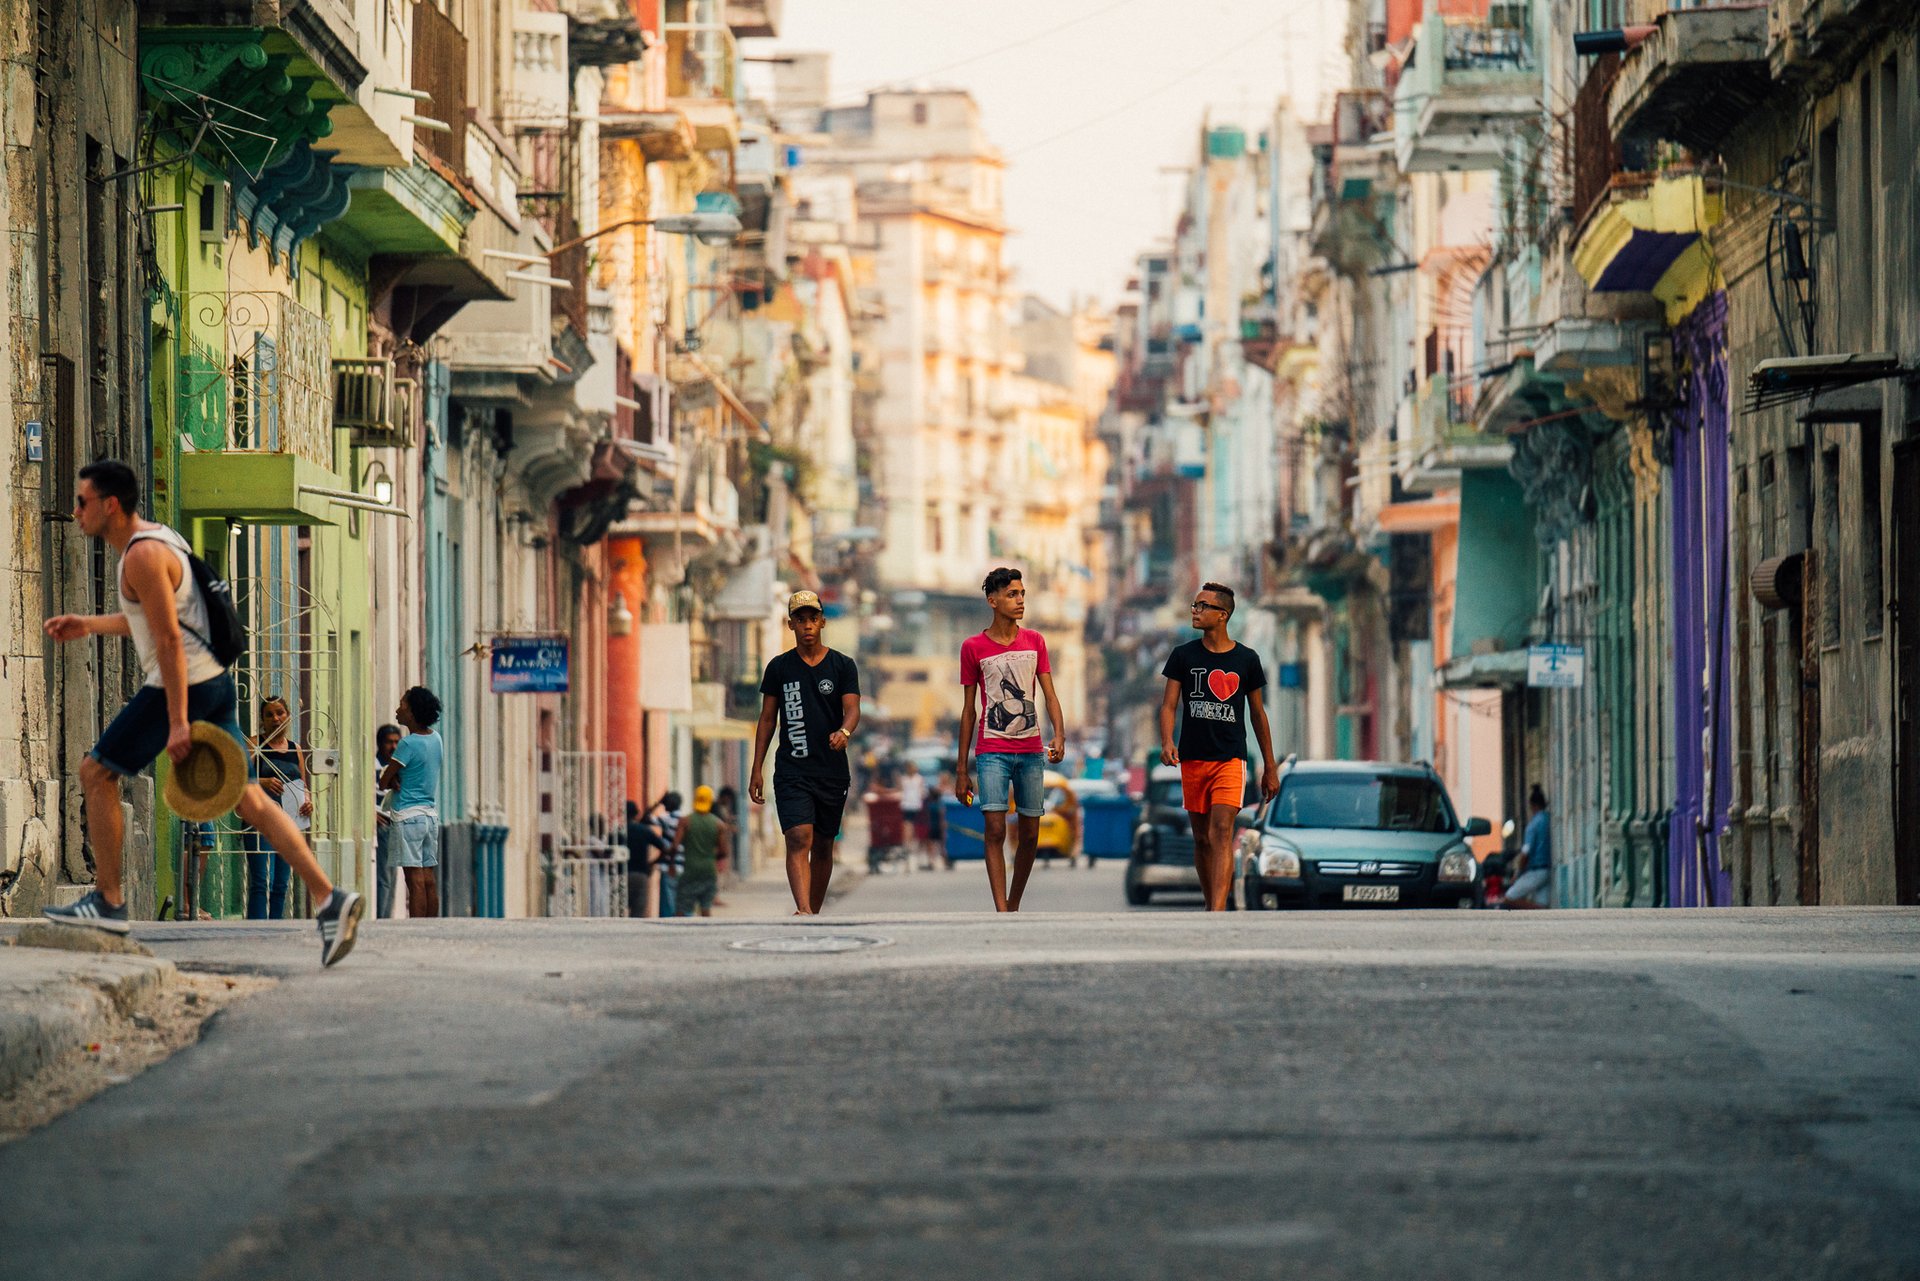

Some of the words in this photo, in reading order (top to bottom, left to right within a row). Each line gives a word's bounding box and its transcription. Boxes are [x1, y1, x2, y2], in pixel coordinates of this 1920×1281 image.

[1190, 668, 1207, 697] I
[783, 681, 808, 758] CONVERSE
[1189, 700, 1236, 722] VENEZIA
